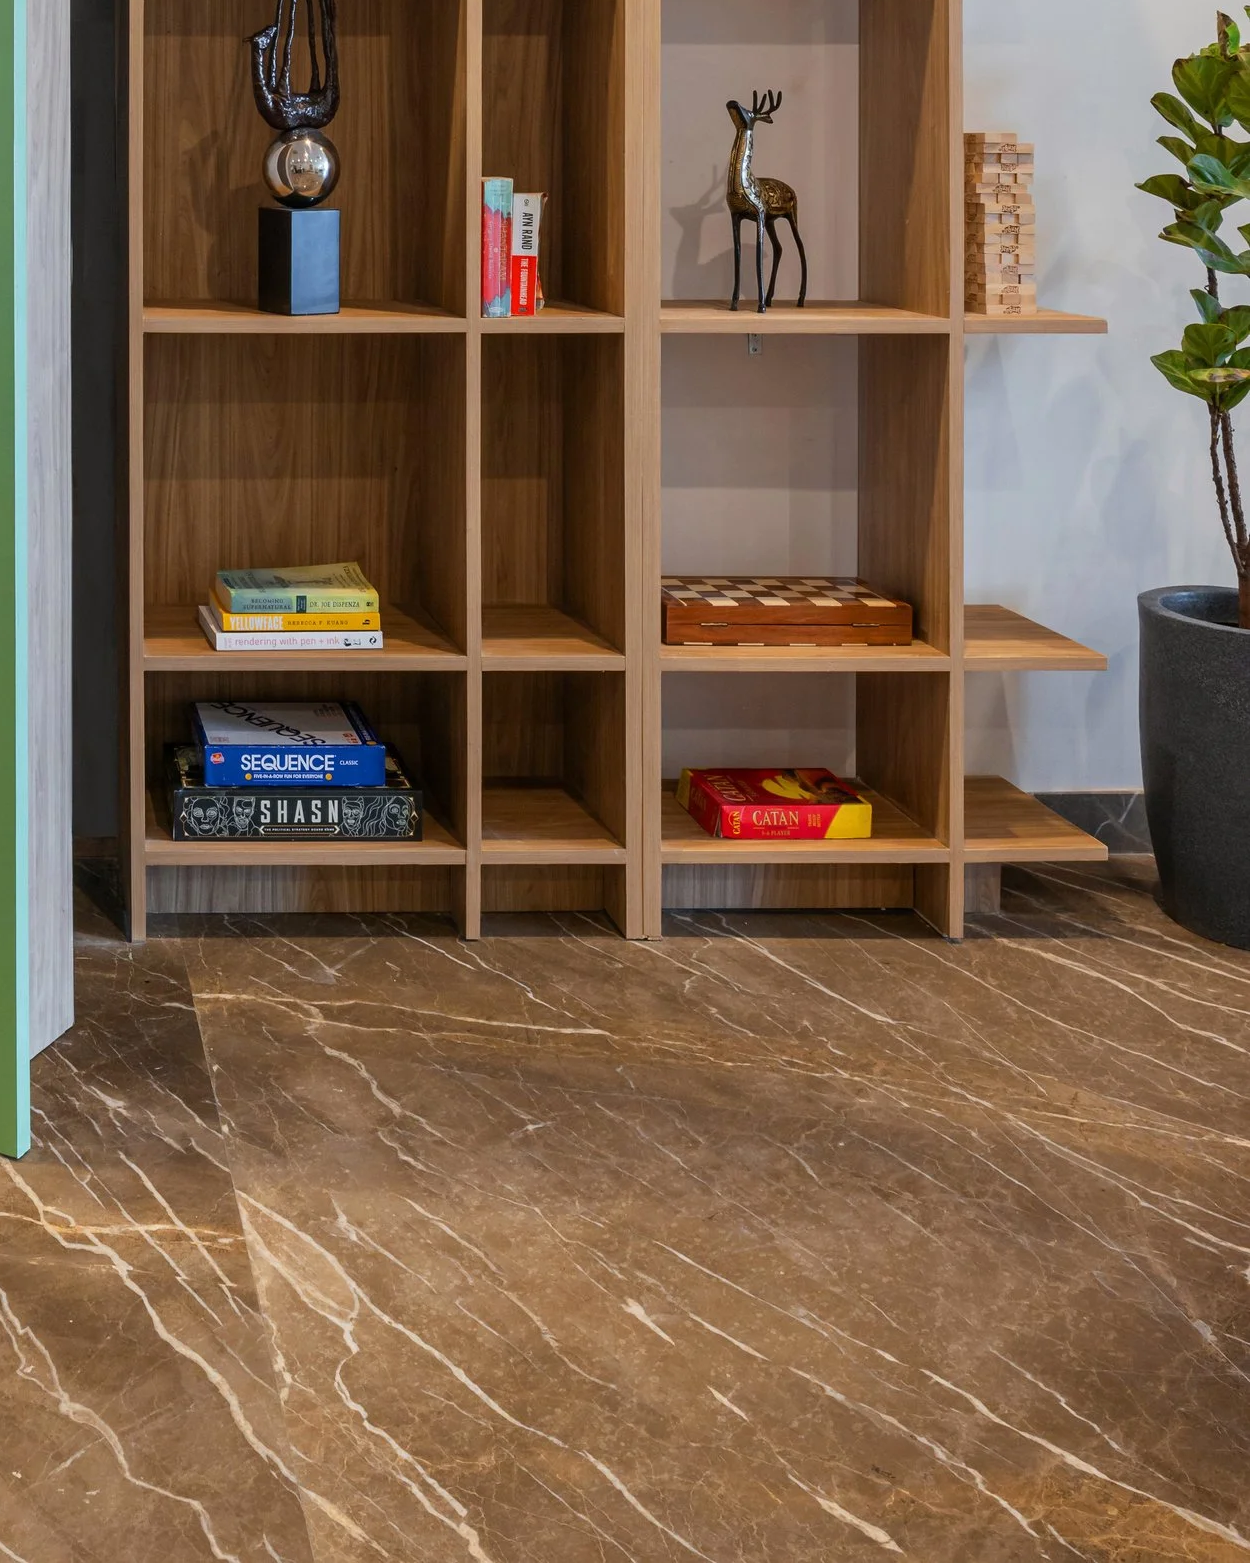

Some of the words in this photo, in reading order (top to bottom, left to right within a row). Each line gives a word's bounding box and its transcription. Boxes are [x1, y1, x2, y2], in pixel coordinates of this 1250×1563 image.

[522, 212, 533, 226] AYN
[521, 230, 533, 250] RAND
[521, 258, 529, 268] THE
[519, 269, 528, 306] FOUNTAINHEAD
[230, 616, 284, 630] YELLOWFACE
[235, 638, 277, 648] rendering
[300, 639, 316, 648] pen
[327, 637, 339, 645] ink
[241, 754, 335, 771] SEQUENCE
[260, 799, 339, 823] SHASN
[752, 810, 799, 826] CATAN
